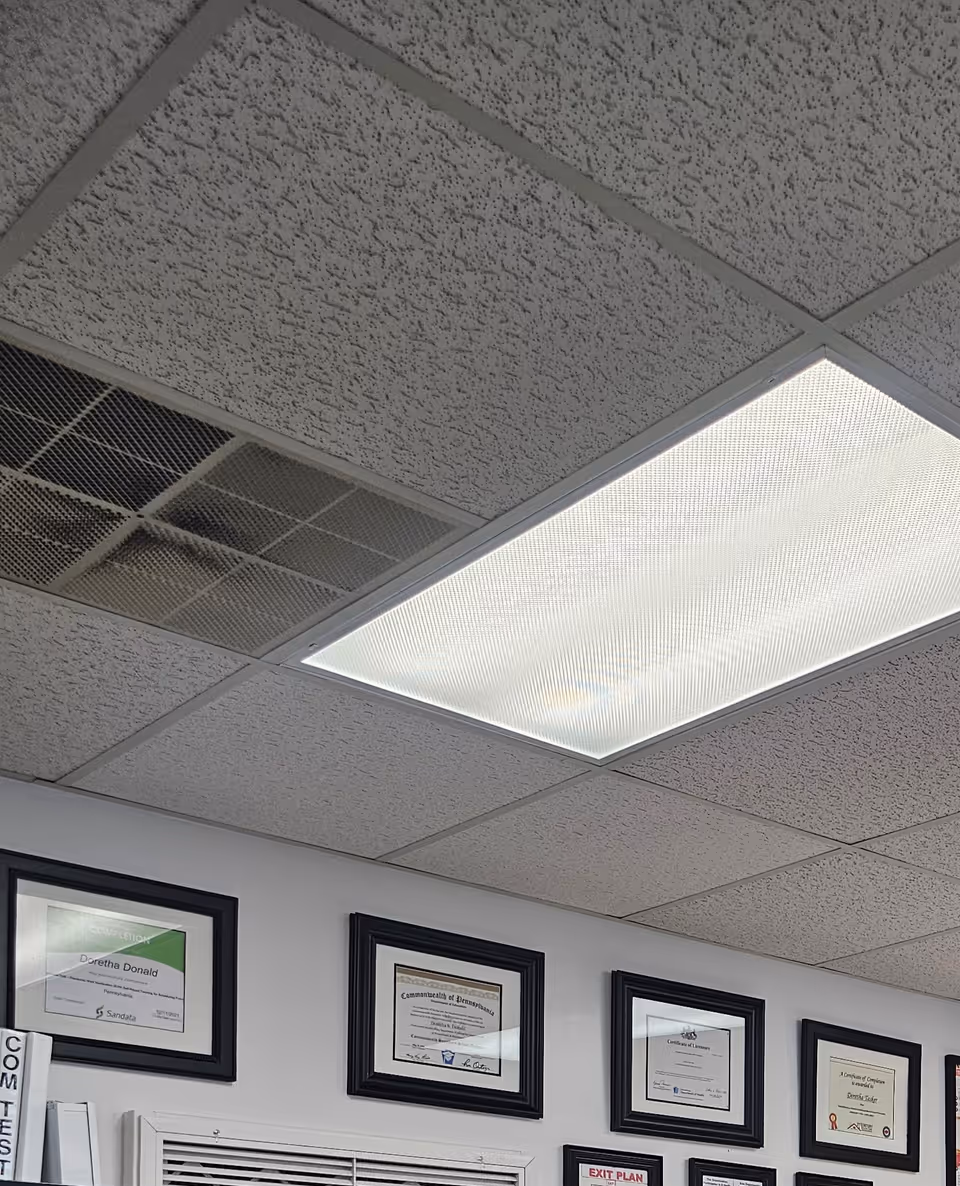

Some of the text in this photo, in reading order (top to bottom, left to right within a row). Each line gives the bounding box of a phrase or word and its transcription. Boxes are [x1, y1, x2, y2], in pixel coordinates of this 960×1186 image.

[80, 954, 120, 970] Doretha
[123, 963, 159, 978] Donald
[106, 1009, 137, 1022] Sandata
[400, 991, 447, 1000] Commonwealth
[456, 995, 495, 1017] Pennsylvania
[0, 1035, 22, 1176] COM TEST
[589, 1167, 643, 1183] EXIT PLAN
